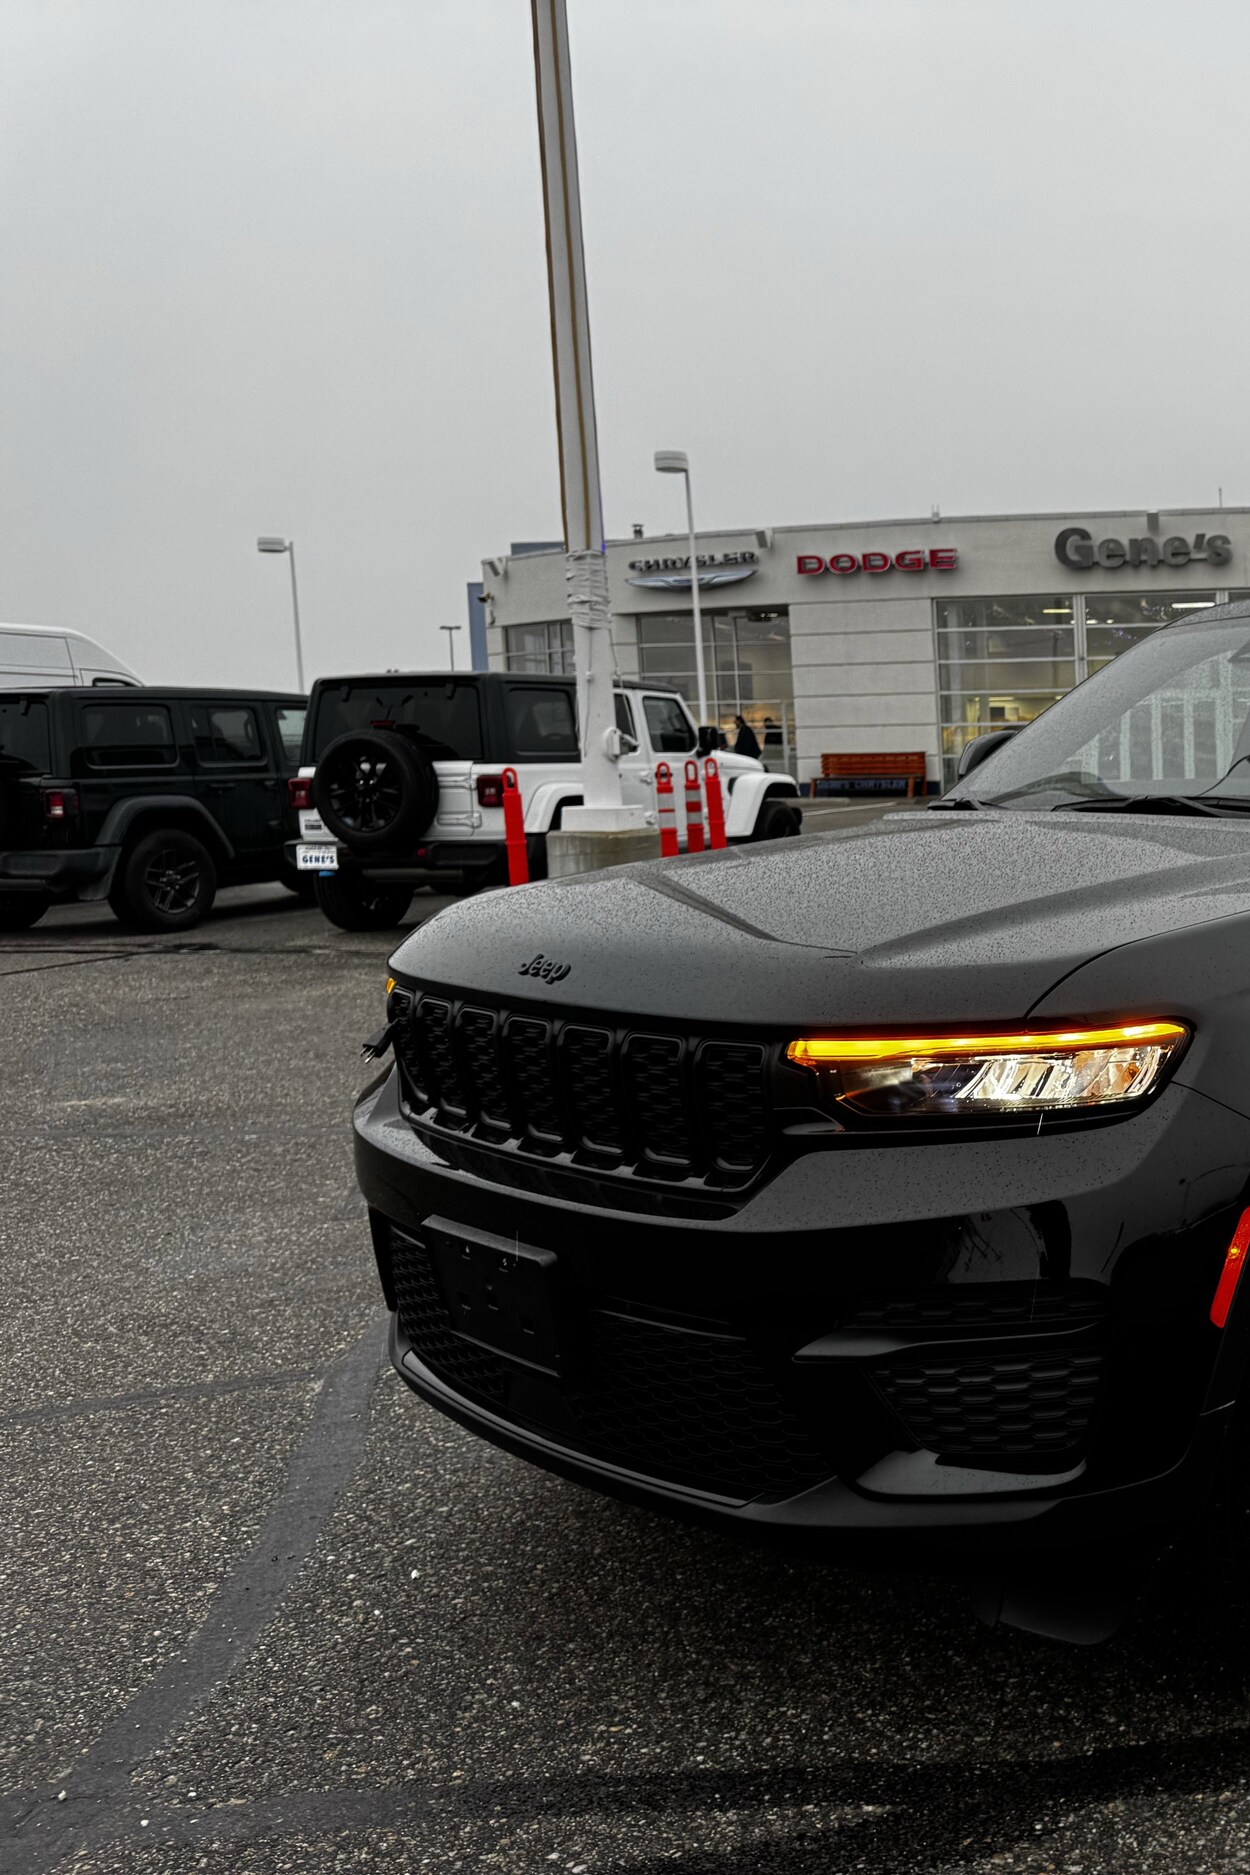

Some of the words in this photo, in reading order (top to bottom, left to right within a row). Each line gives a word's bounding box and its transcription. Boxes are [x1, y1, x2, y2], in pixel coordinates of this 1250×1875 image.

[629, 551, 759, 572] CHRYSLER
[797, 548, 958, 576] DODGE
[1055, 527, 1233, 570] Gene's
[518, 953, 571, 984] Jeep
